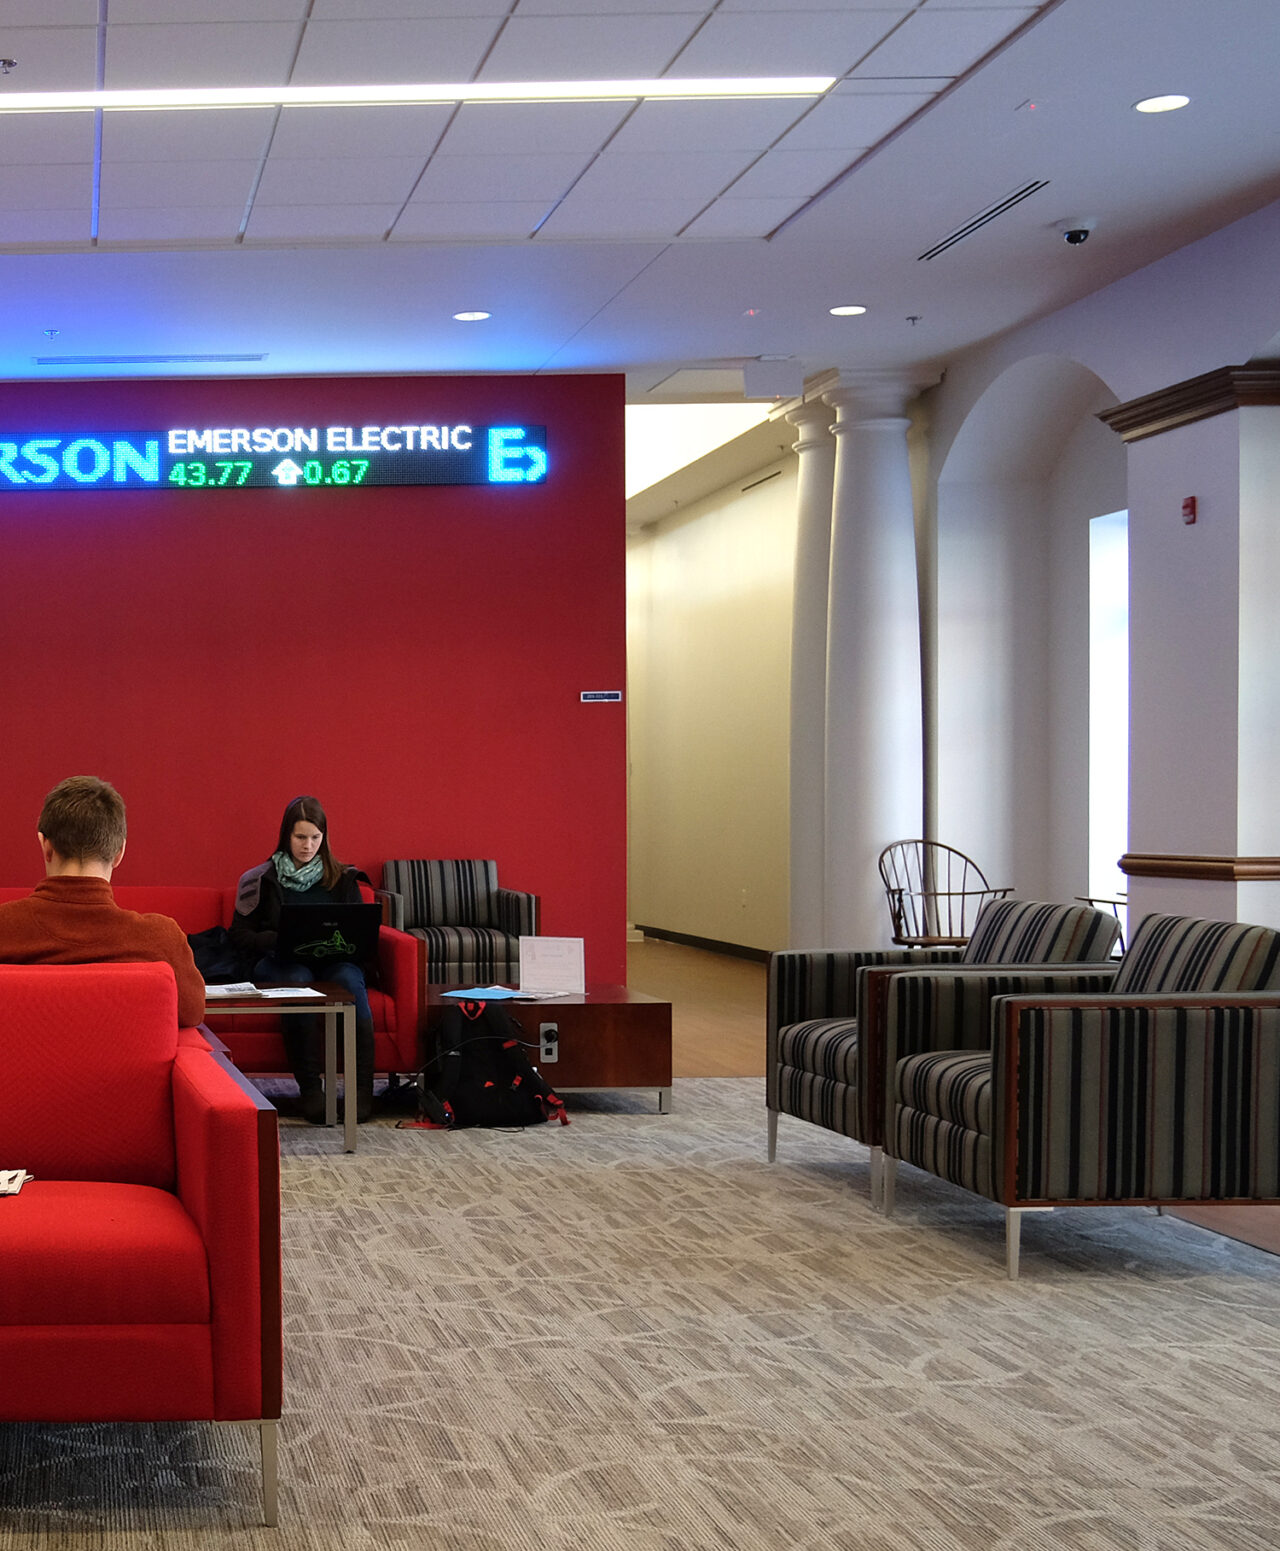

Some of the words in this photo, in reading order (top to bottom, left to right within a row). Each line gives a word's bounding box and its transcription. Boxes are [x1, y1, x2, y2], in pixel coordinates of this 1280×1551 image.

[168, 427, 318, 453] EMERSON
[326, 425, 472, 451] ELECTRIC
[168, 461, 253, 486] 43.77
[303, 459, 370, 485] 0.67
